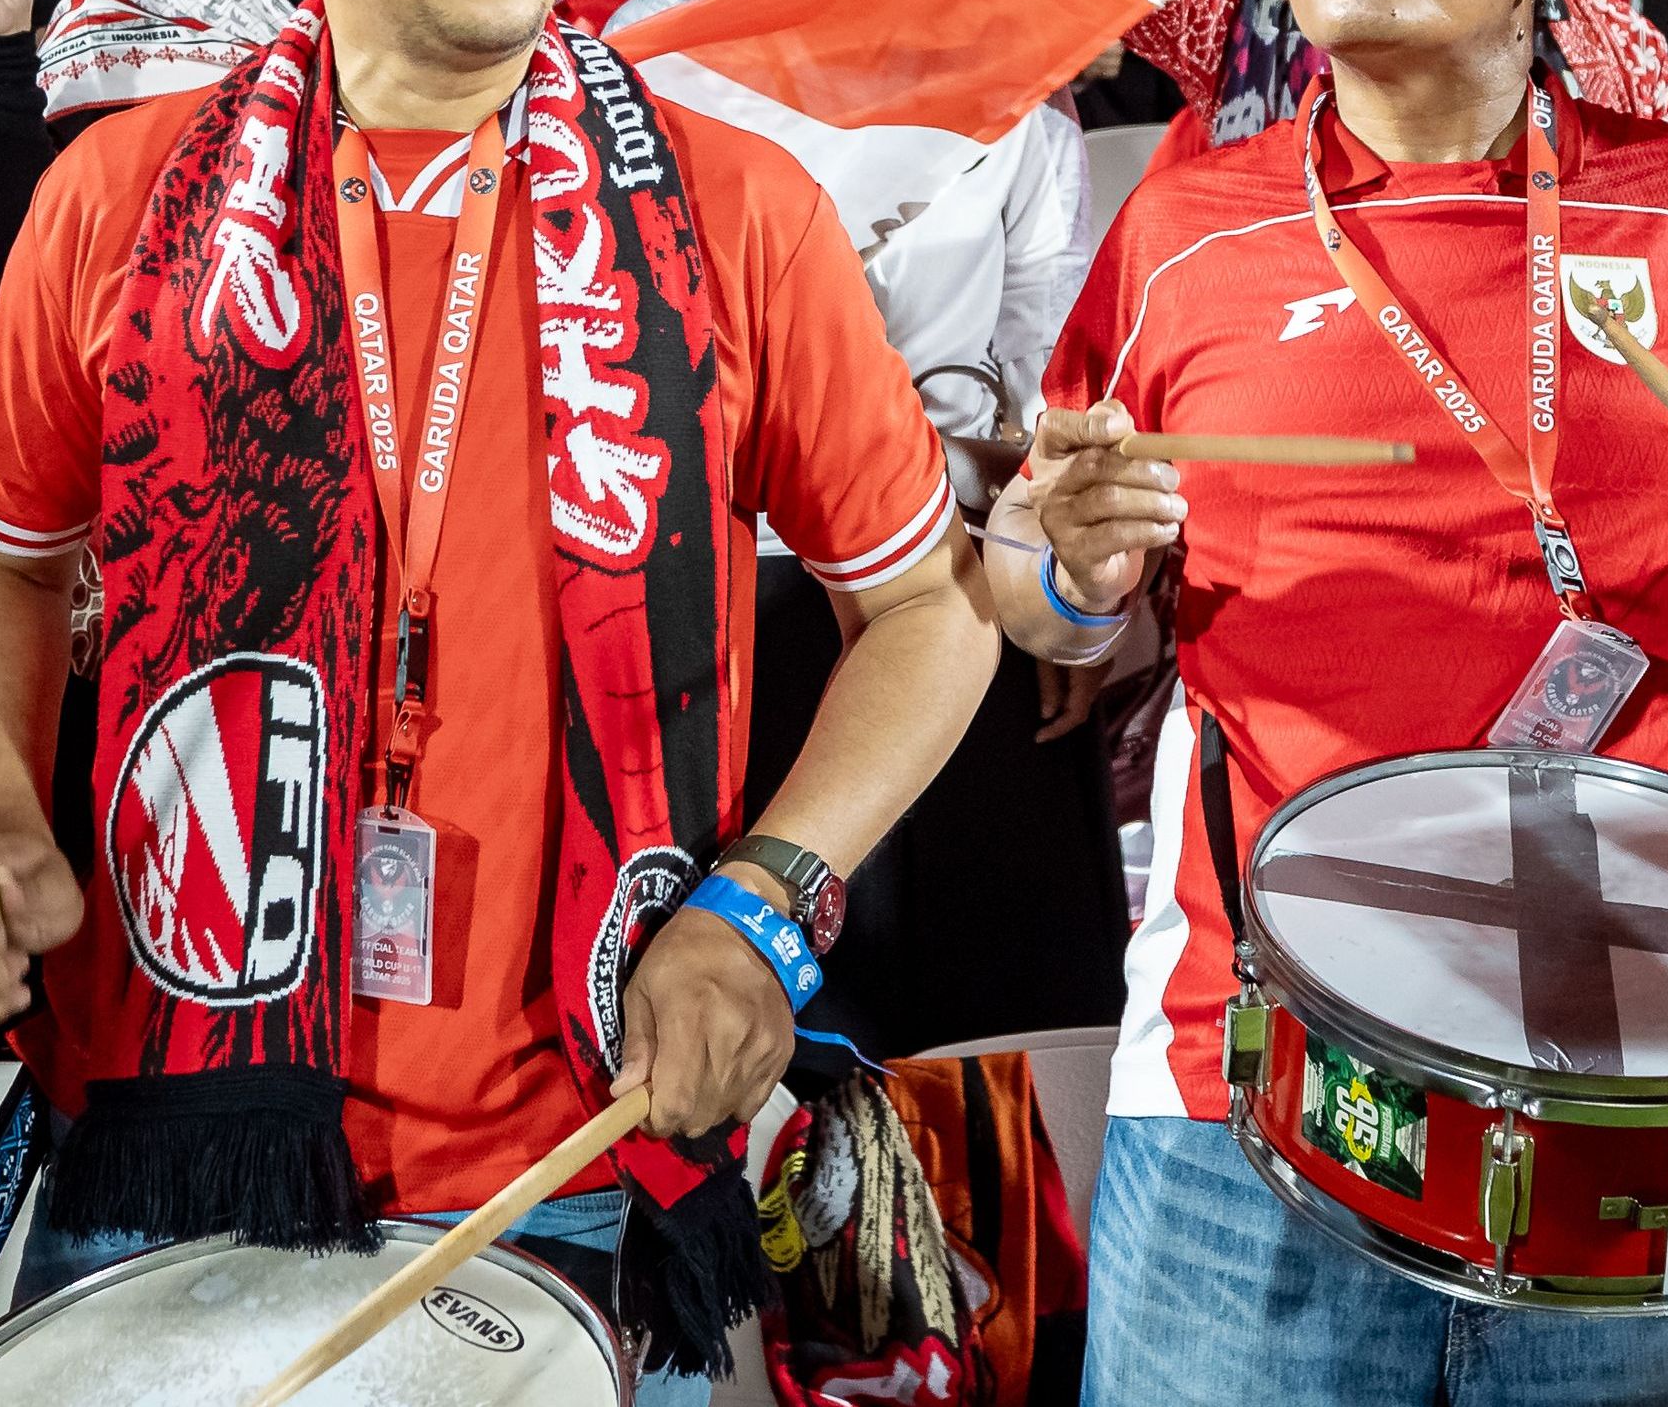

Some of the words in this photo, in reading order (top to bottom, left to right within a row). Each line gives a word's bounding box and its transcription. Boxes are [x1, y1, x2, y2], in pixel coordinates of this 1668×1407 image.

[111, 30, 181, 42] INDONESIA
[564, 22, 664, 189] footba
[1531, 234, 1556, 318] QATAR
[1573, 260, 1632, 272] INDONESIA
[353, 292, 389, 396] QATAR
[418, 360, 465, 494] GARUDA
[442, 250, 483, 356] QATAR
[1378, 304, 1444, 383] QATAR
[1435, 378, 1487, 434] 2025
[1531, 322, 1557, 433] GARUDA
[367, 403, 398, 471] 2025
[361, 941, 394, 955] FFICIAL
[429, 1291, 513, 1345] EVANS
